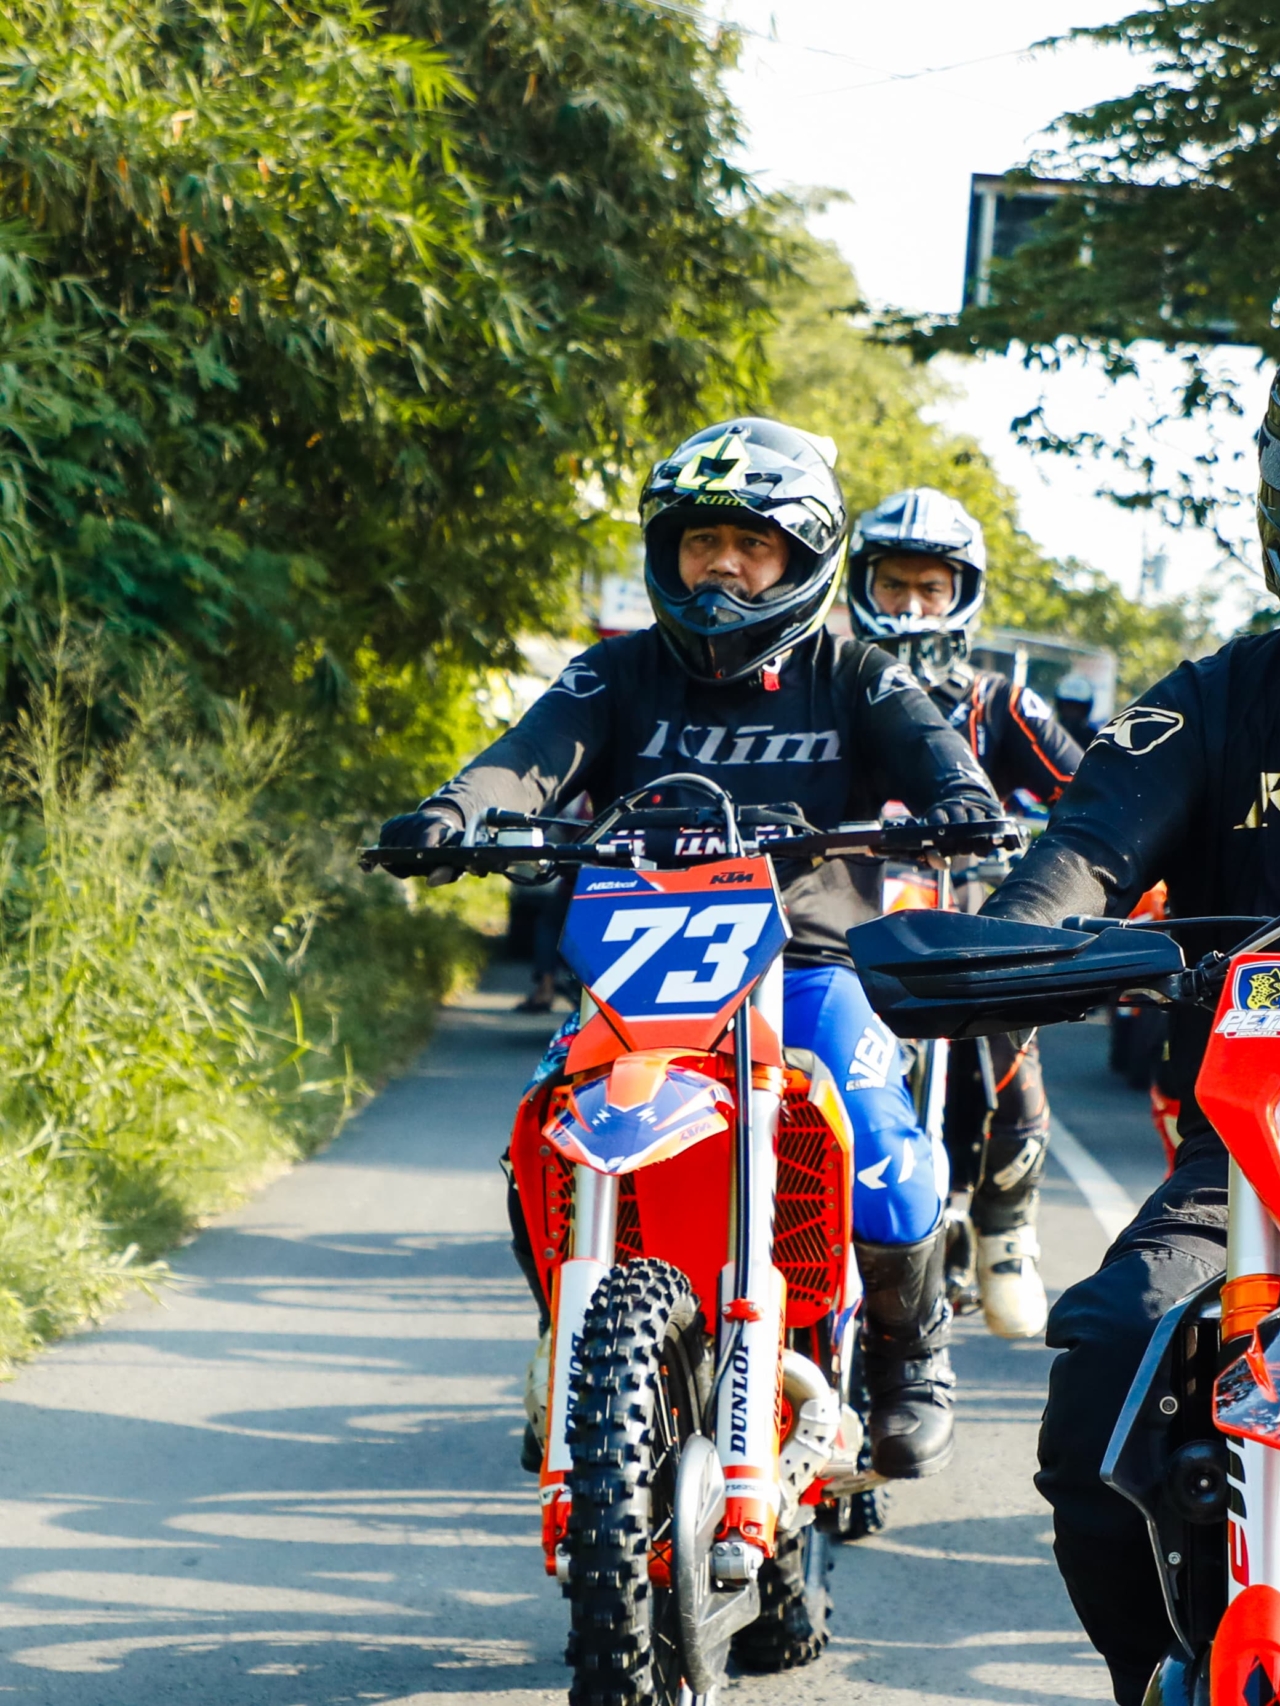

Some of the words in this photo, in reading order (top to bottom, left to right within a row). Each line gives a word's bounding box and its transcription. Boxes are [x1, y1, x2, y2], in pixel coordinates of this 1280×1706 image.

[710, 871, 753, 885] KTM
[590, 903, 771, 1003] 73
[845, 1012, 897, 1091] VEL
